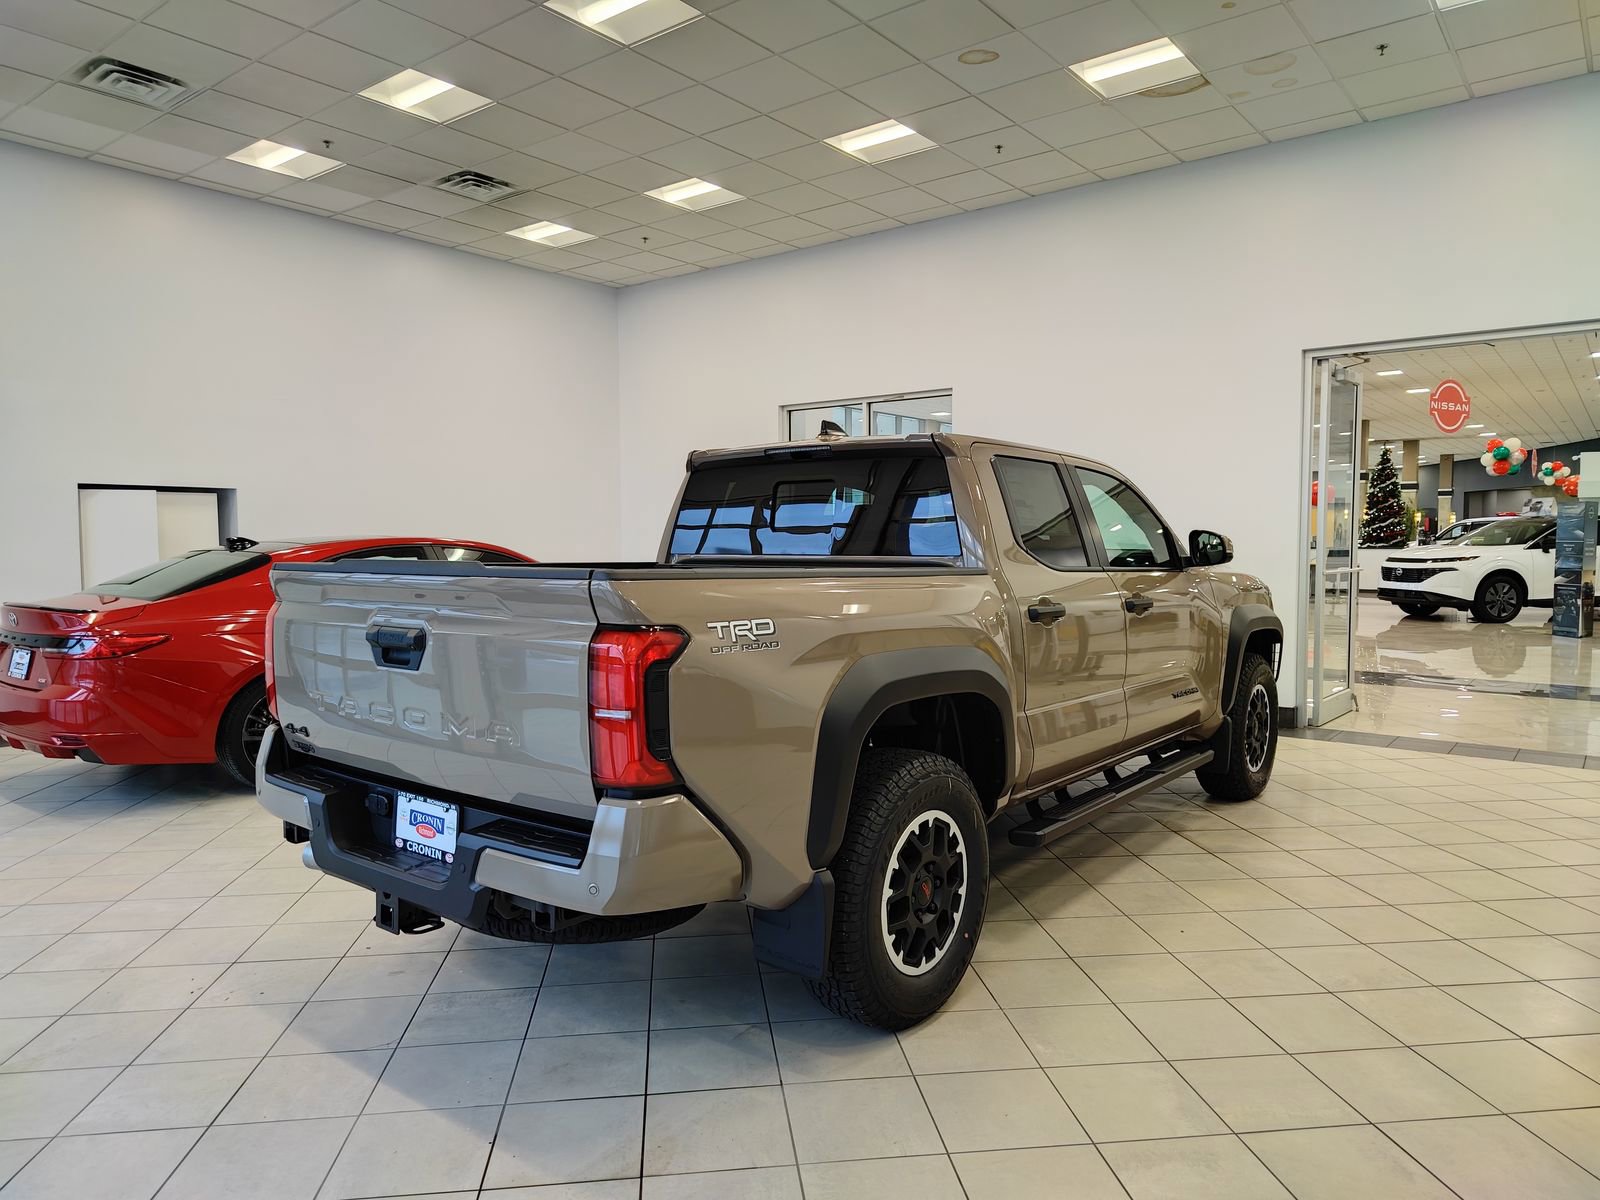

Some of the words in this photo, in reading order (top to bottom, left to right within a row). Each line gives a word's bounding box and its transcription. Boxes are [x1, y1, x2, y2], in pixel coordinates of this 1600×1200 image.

[1431, 400, 1469, 412] NISSAN
[706, 618, 776, 643] TRD
[710, 645, 739, 655] OFF
[741, 641, 781, 652] ROAD
[308, 691, 522, 747] TACOMA
[411, 811, 444, 832] CRONIN
[406, 841, 442, 860] CRONIN
